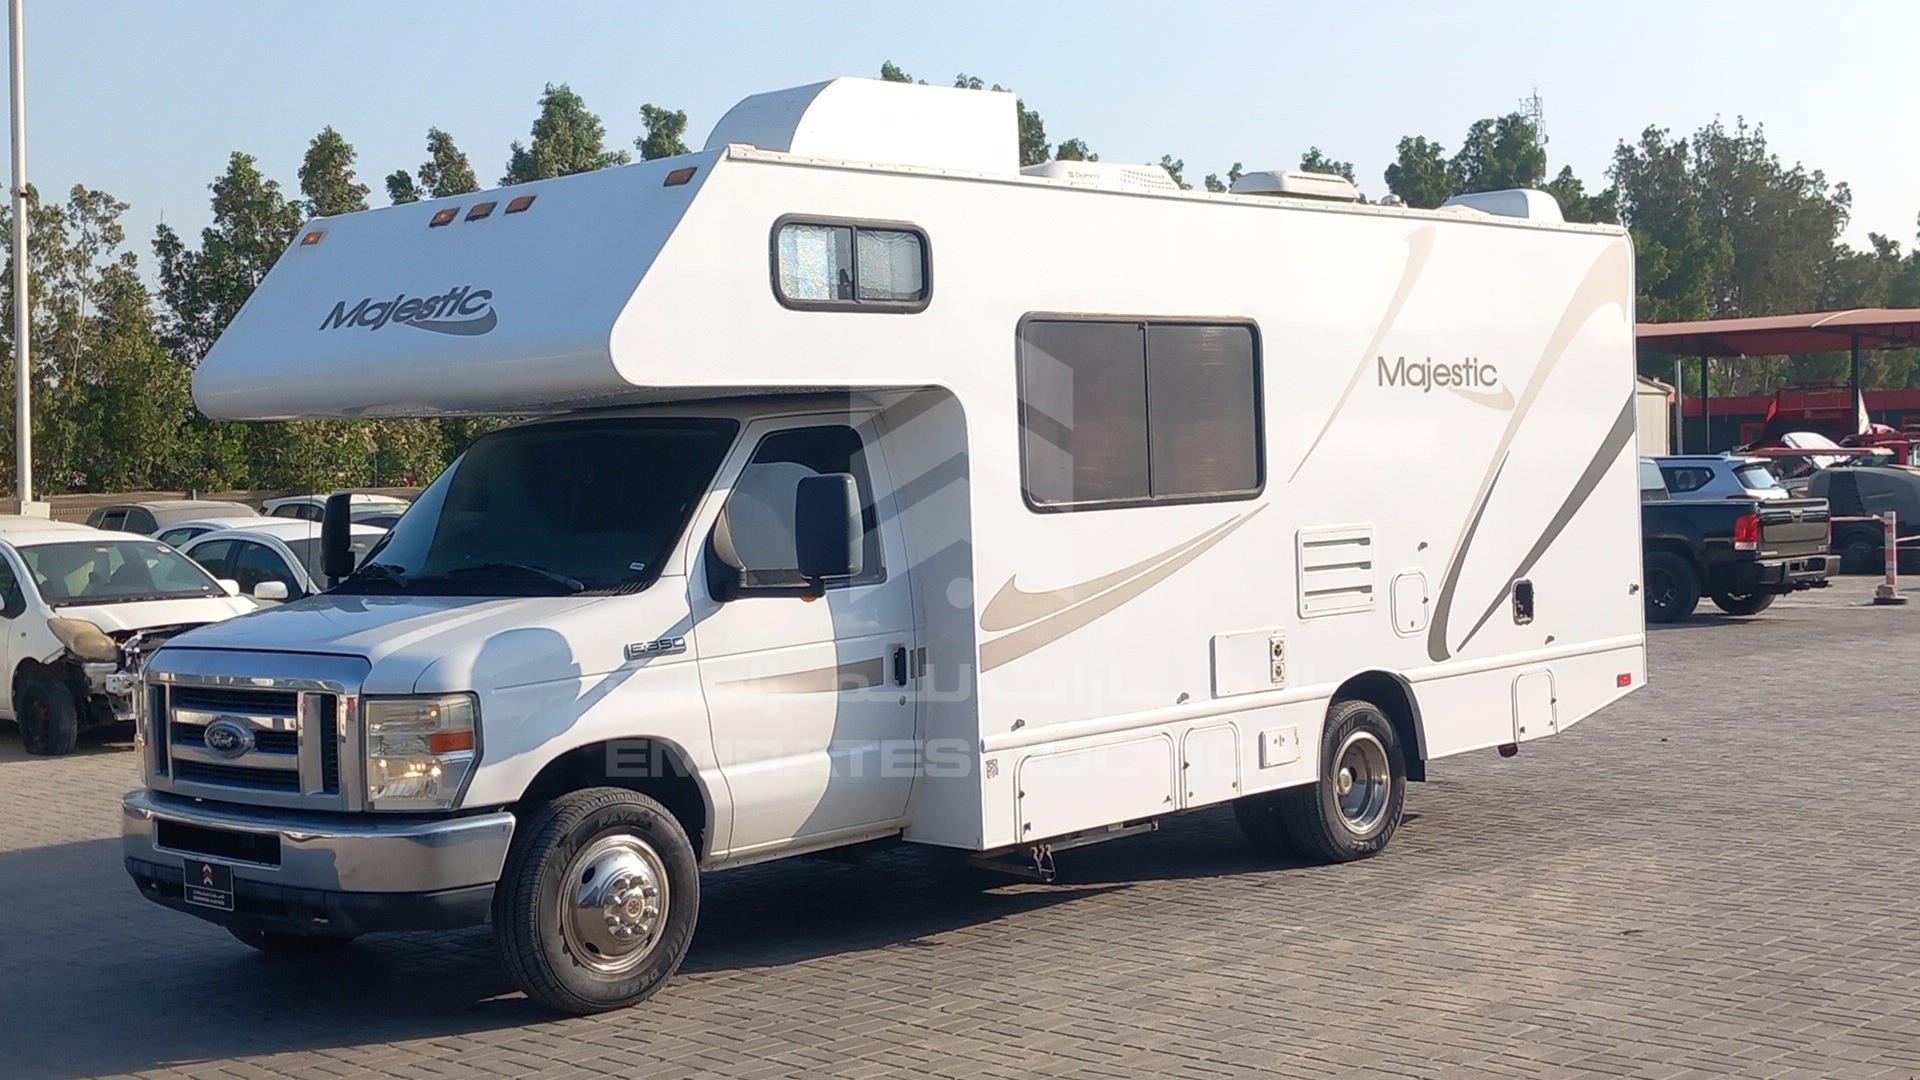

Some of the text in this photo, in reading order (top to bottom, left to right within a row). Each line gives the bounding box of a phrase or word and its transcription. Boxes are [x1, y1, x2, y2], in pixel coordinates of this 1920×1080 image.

[319, 286, 493, 332] Majestic
[1377, 356, 1498, 394] Majestic
[211, 730, 233, 748] Ford
